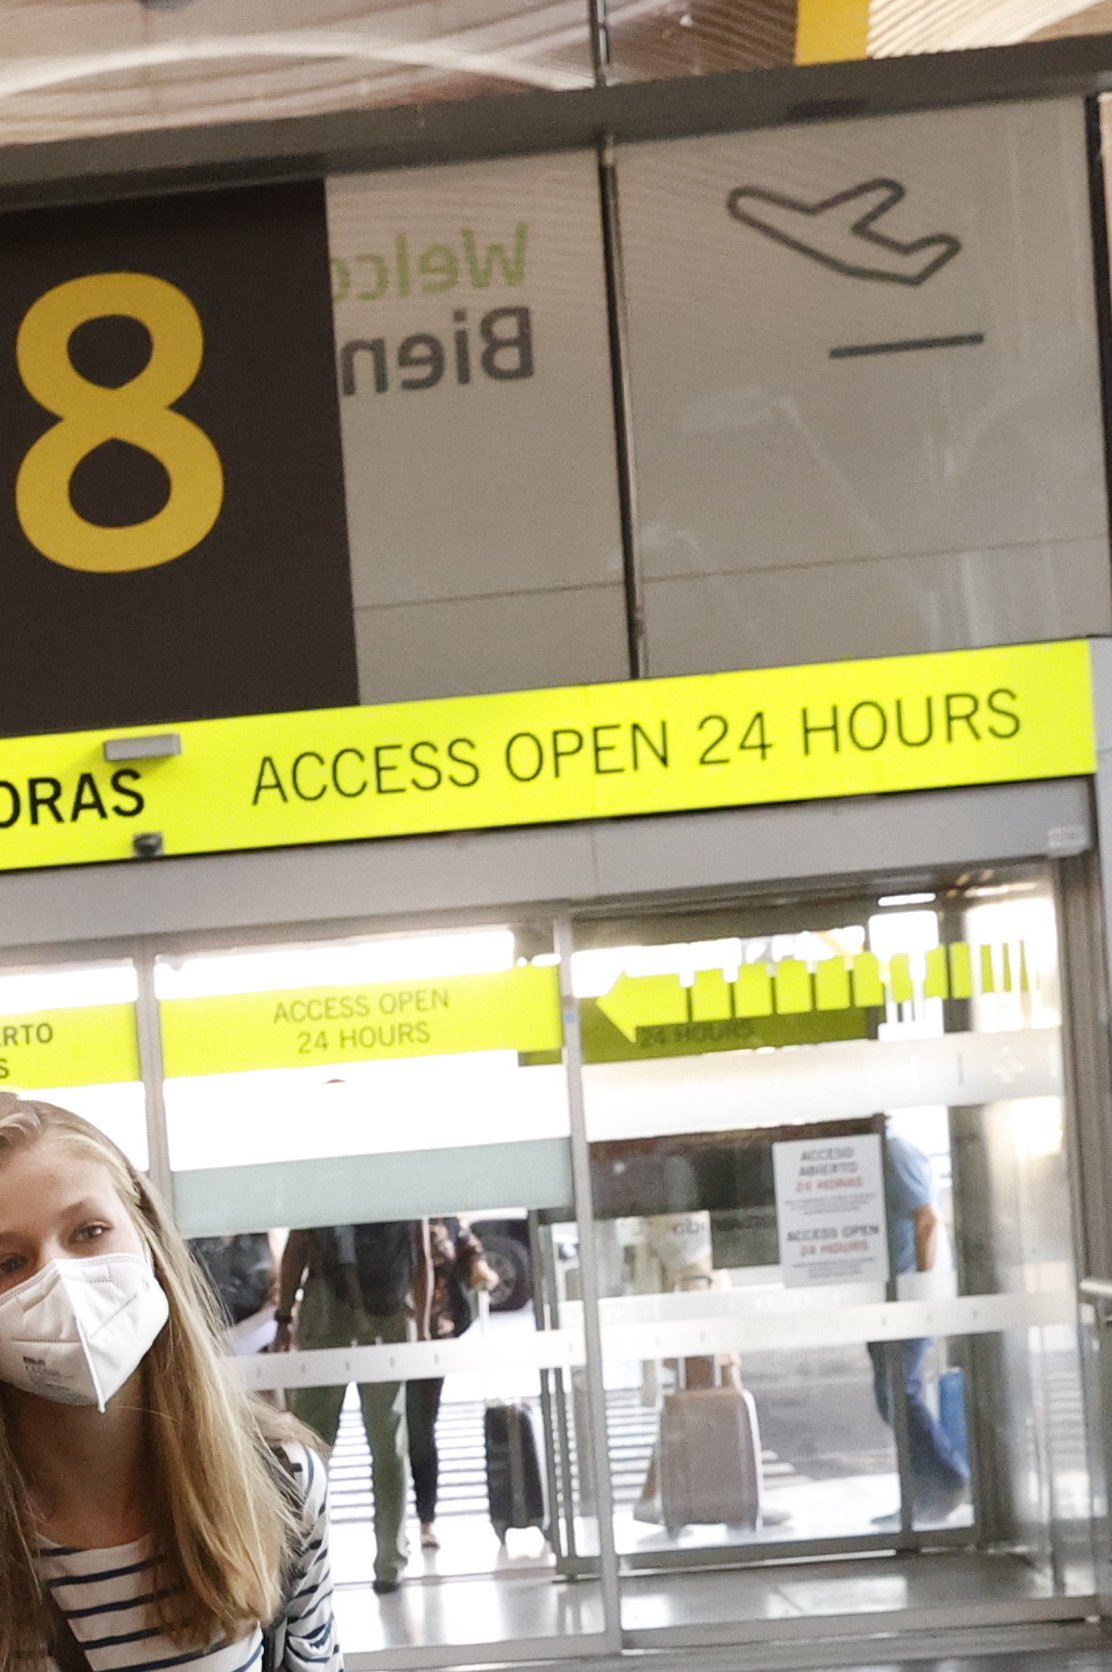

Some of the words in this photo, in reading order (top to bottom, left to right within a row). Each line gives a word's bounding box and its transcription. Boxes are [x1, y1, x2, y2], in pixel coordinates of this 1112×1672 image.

[16, 272, 224, 573] 8
[251, 737, 481, 806] ACCESS
[504, 720, 669, 782] OPEN
[697, 711, 774, 766] 24
[801, 688, 1022, 756] HOURS
[273, 993, 371, 1024] ACCESS
[378, 987, 450, 1015] OPEN
[297, 1031, 329, 1054] 24
[339, 1020, 432, 1050] HOURS
